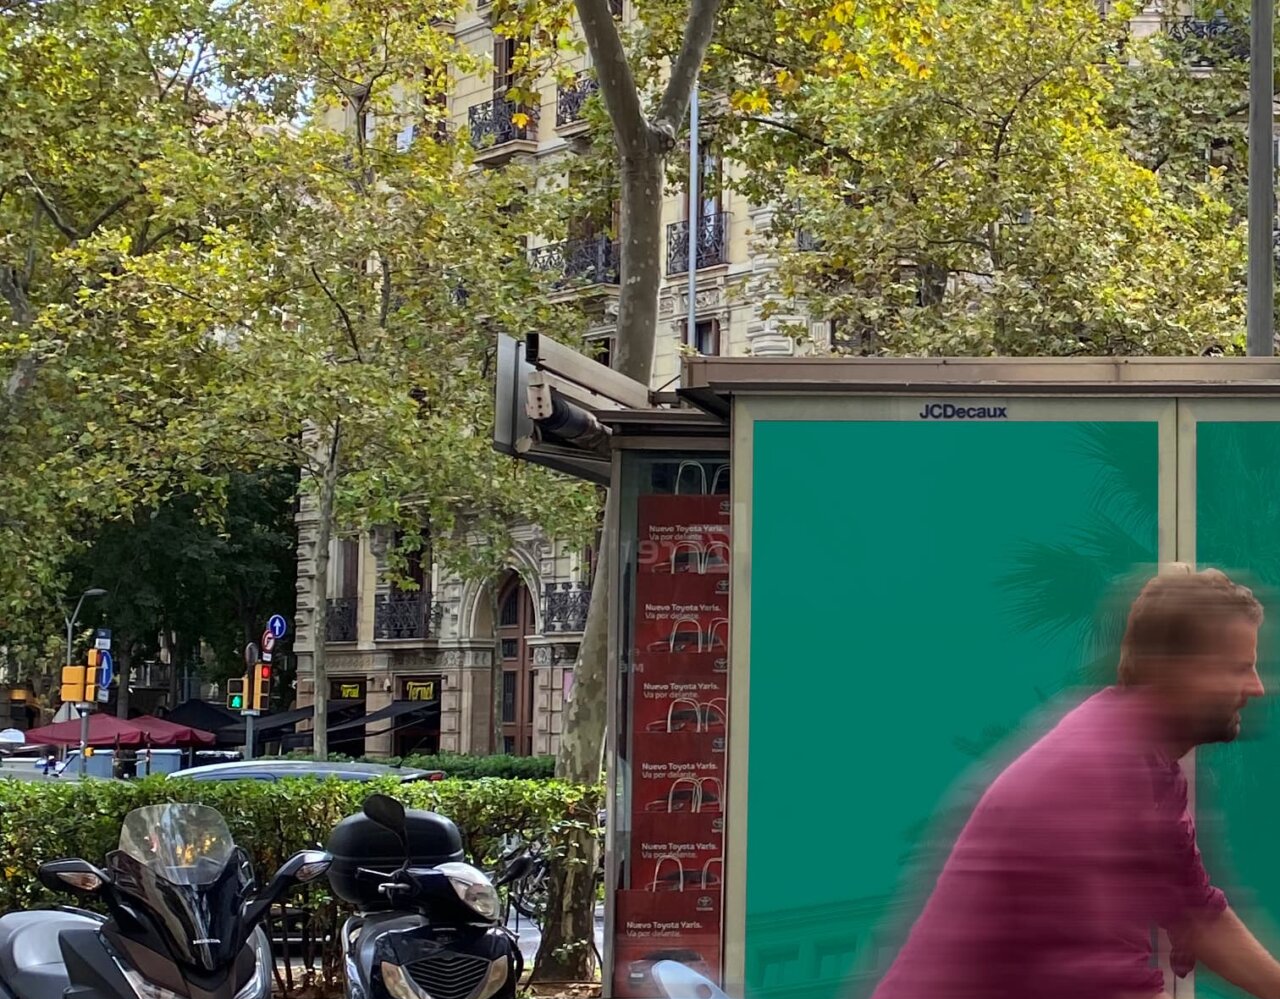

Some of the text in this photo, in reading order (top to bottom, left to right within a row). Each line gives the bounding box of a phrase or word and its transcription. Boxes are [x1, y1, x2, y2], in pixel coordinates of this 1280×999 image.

[919, 403, 1008, 419] JCDecaux
[670, 683, 697, 691] Toyota
[668, 763, 695, 771] Toyota
[696, 762, 718, 770] Yaris.
[653, 922, 679, 930] Toyota
[680, 921, 703, 929] Yaris.
